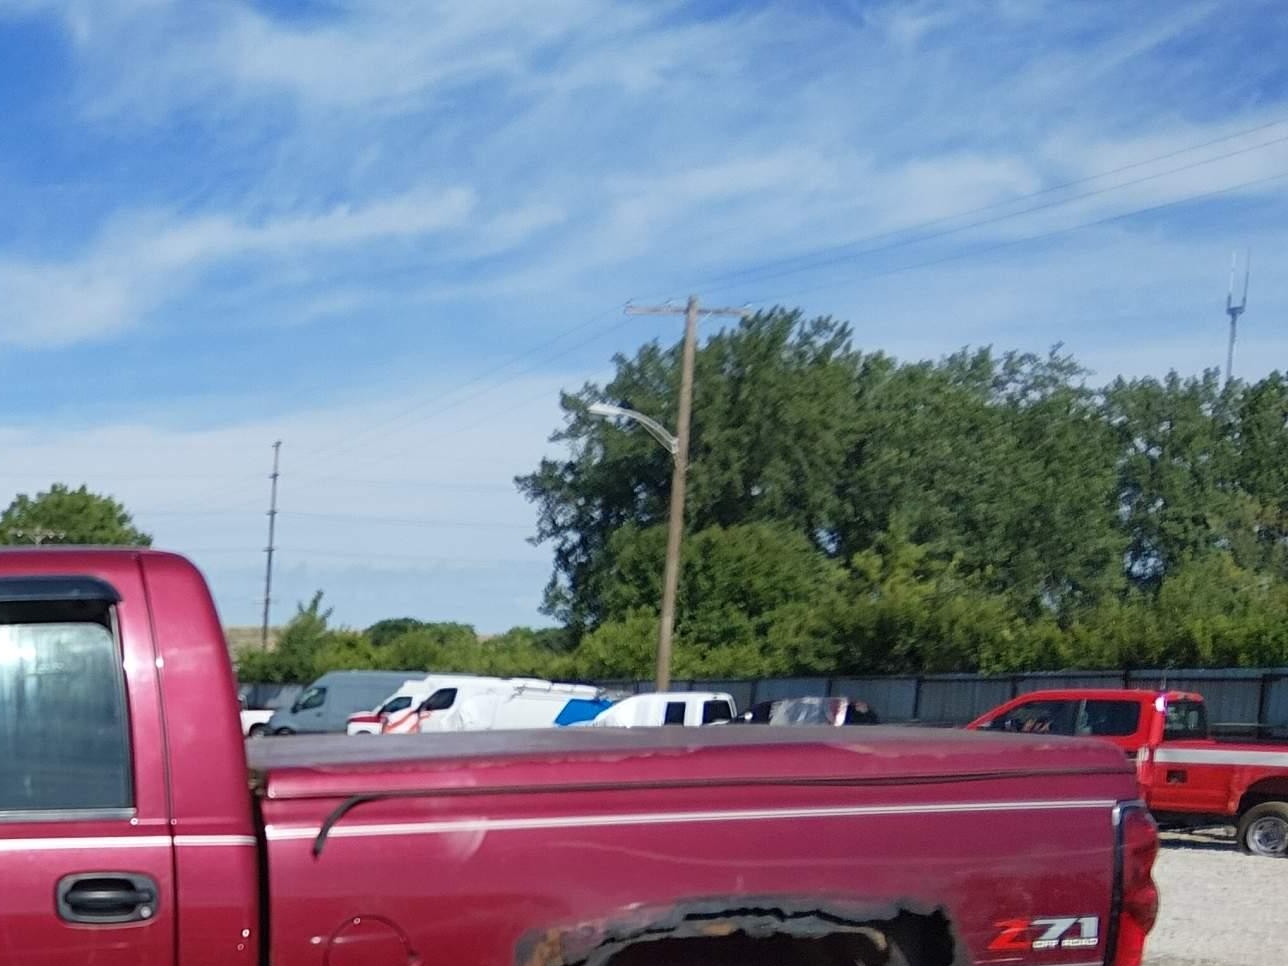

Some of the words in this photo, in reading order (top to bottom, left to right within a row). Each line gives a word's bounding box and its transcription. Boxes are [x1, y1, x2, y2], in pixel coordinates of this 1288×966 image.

[987, 916, 1099, 949] Z71
[1032, 940, 1059, 948] OFF
[1061, 938, 1098, 946] ROAD
